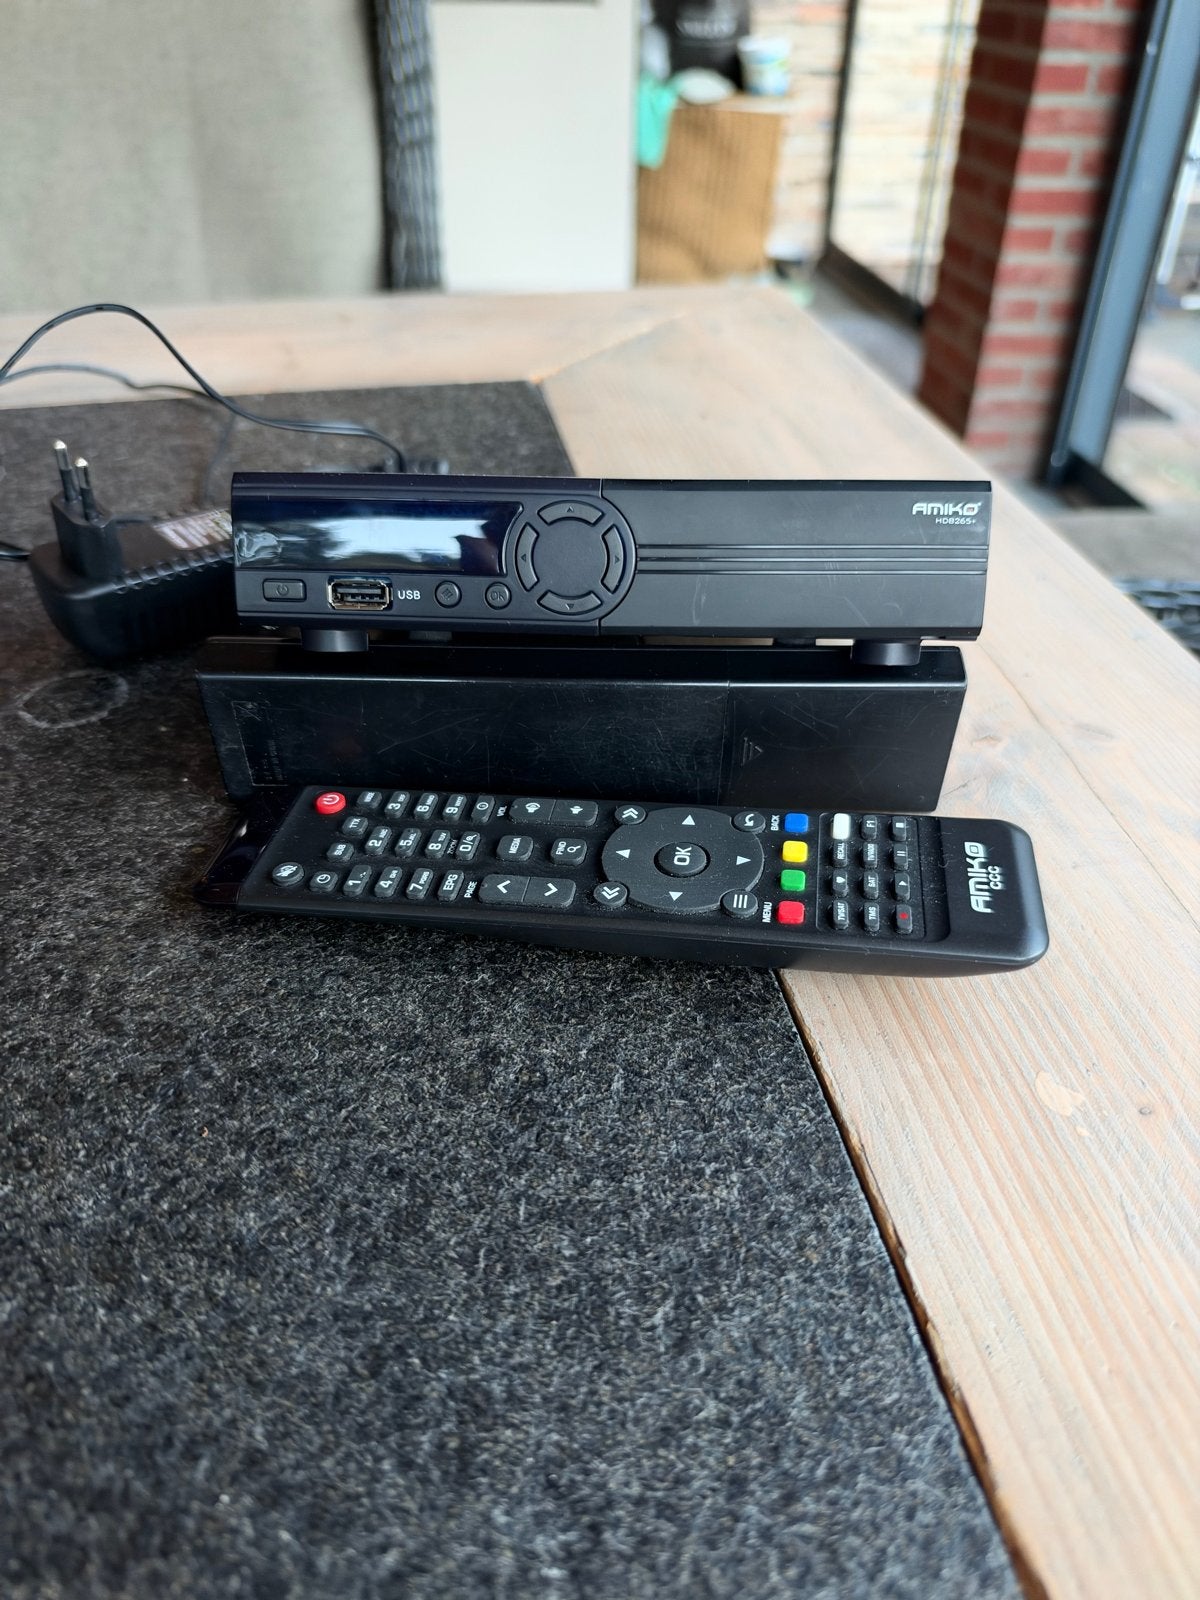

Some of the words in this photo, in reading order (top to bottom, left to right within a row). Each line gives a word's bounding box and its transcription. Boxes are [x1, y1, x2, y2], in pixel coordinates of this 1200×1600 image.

[397, 590, 421, 601] USB
[416, 804, 430, 812] 6
[496, 806, 508, 817] VOL
[349, 818, 361, 829] TTX
[770, 814, 780, 832] BACK
[866, 820, 876, 828] F1
[334, 844, 347, 856] SUB
[369, 839, 382, 847] 2
[447, 840, 458, 855] ZOOM
[508, 837, 522, 854] MEDIA
[556, 841, 567, 855] FIND
[673, 846, 692, 866] OK
[836, 842, 846, 860] RECALL
[379, 880, 393, 888] 4
[443, 874, 458, 891] EPG
[868, 876, 876, 888] SAT
[988, 865, 1002, 890] CCC
[409, 882, 423, 891] 7
[464, 880, 478, 898] PAGE
[762, 901, 773, 923] MENU
[868, 906, 876, 920] TMS
